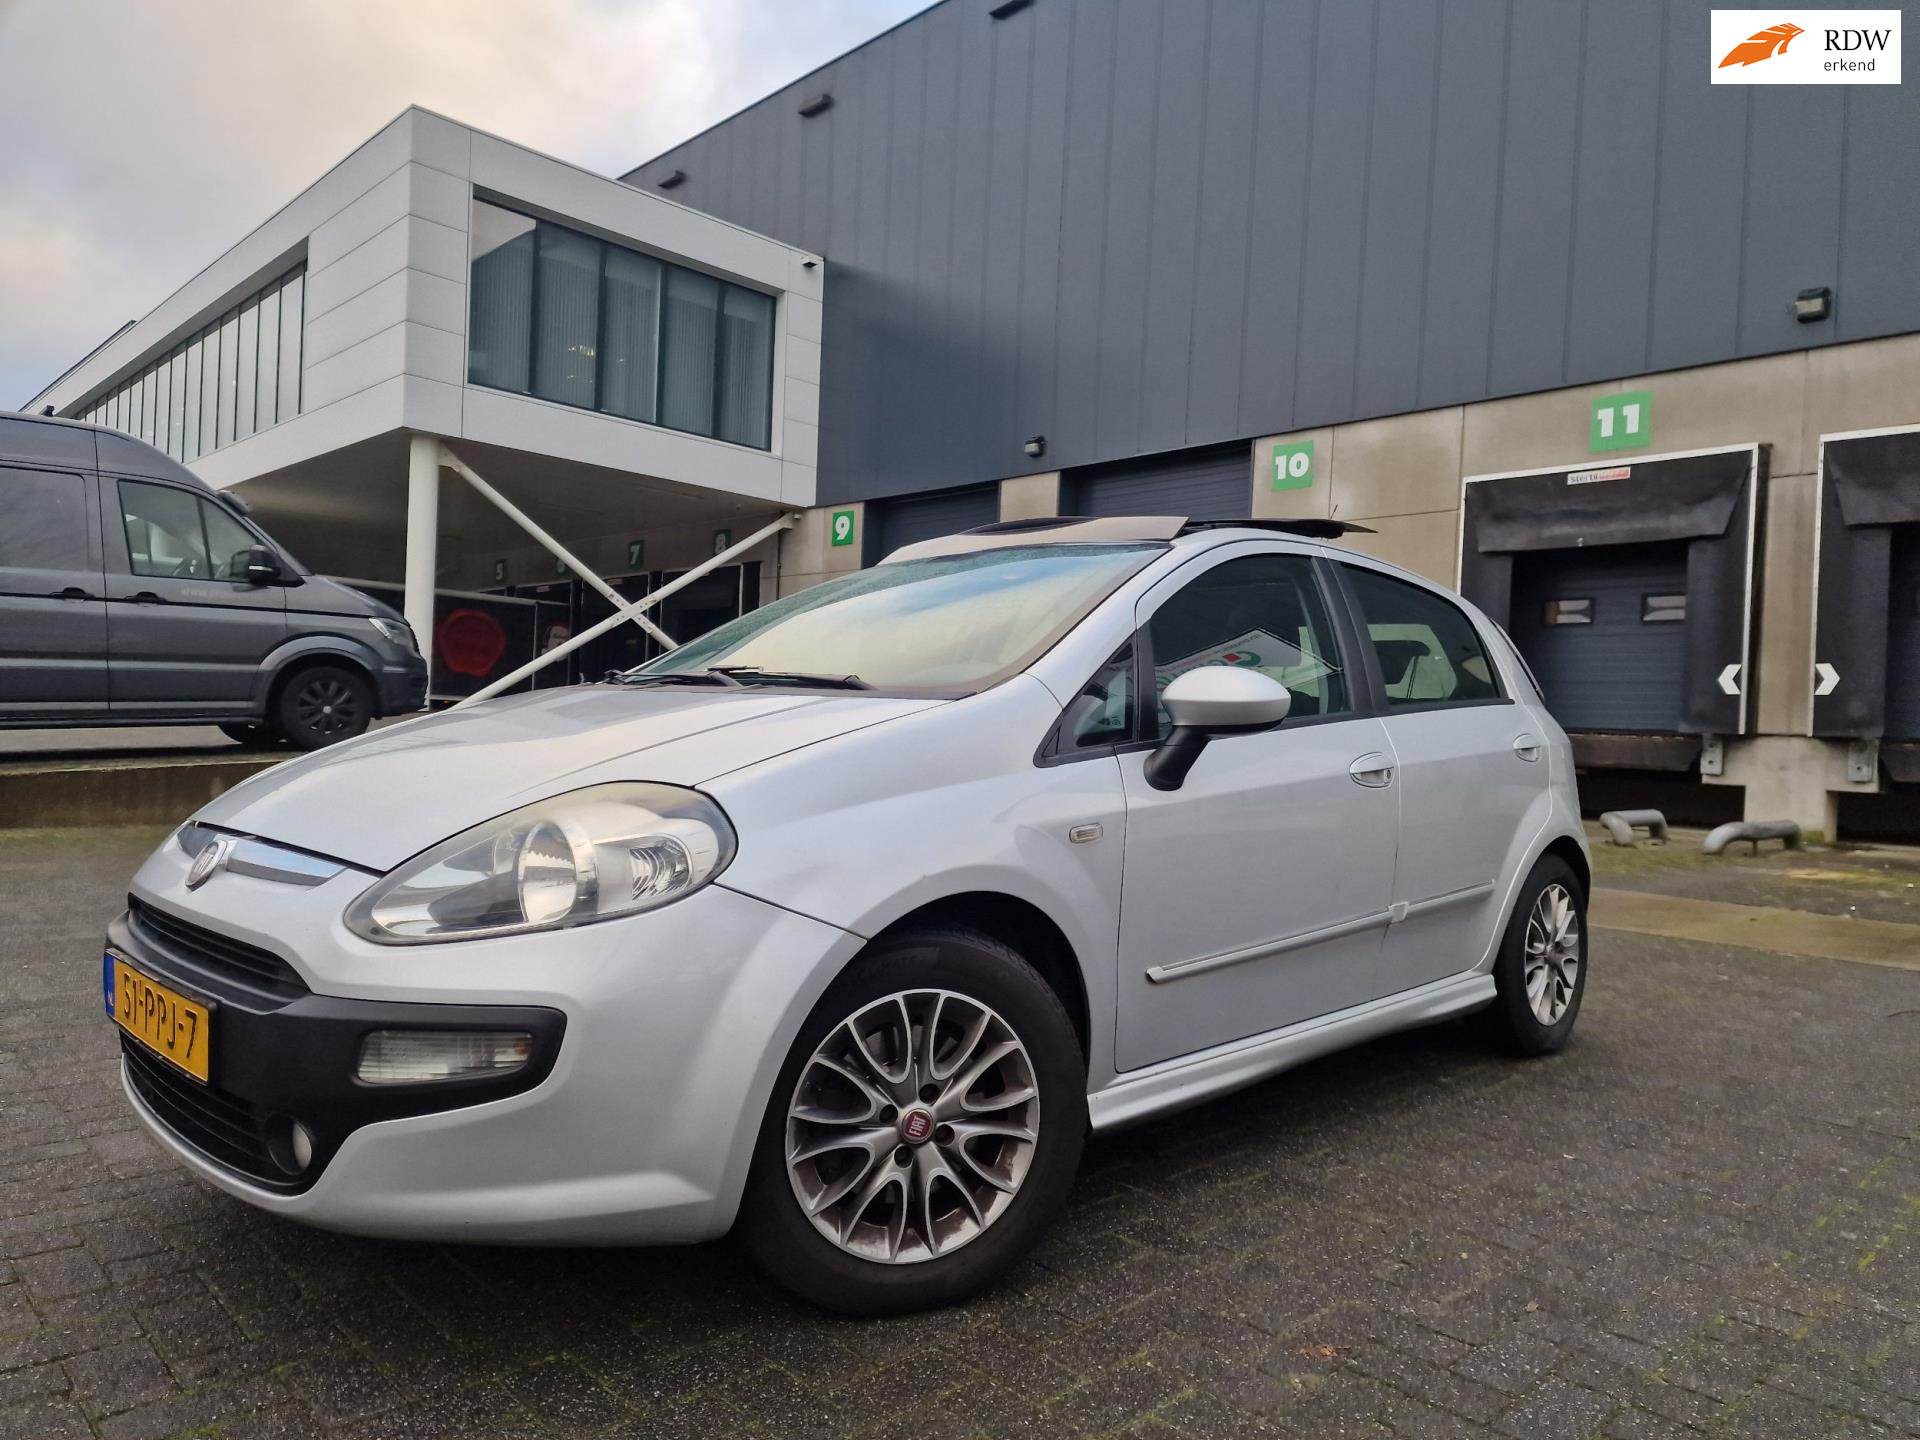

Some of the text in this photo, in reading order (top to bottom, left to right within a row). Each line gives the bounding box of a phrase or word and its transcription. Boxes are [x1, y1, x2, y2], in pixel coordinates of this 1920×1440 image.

[1597, 403, 1640, 438] 11
[1275, 452, 1309, 480] 10
[835, 515, 850, 541] 9
[630, 544, 640, 565] 7
[495, 562, 504, 580] 5
[123, 971, 198, 1060] 51-PPJ-7
[908, 1115, 927, 1136] FIAT
